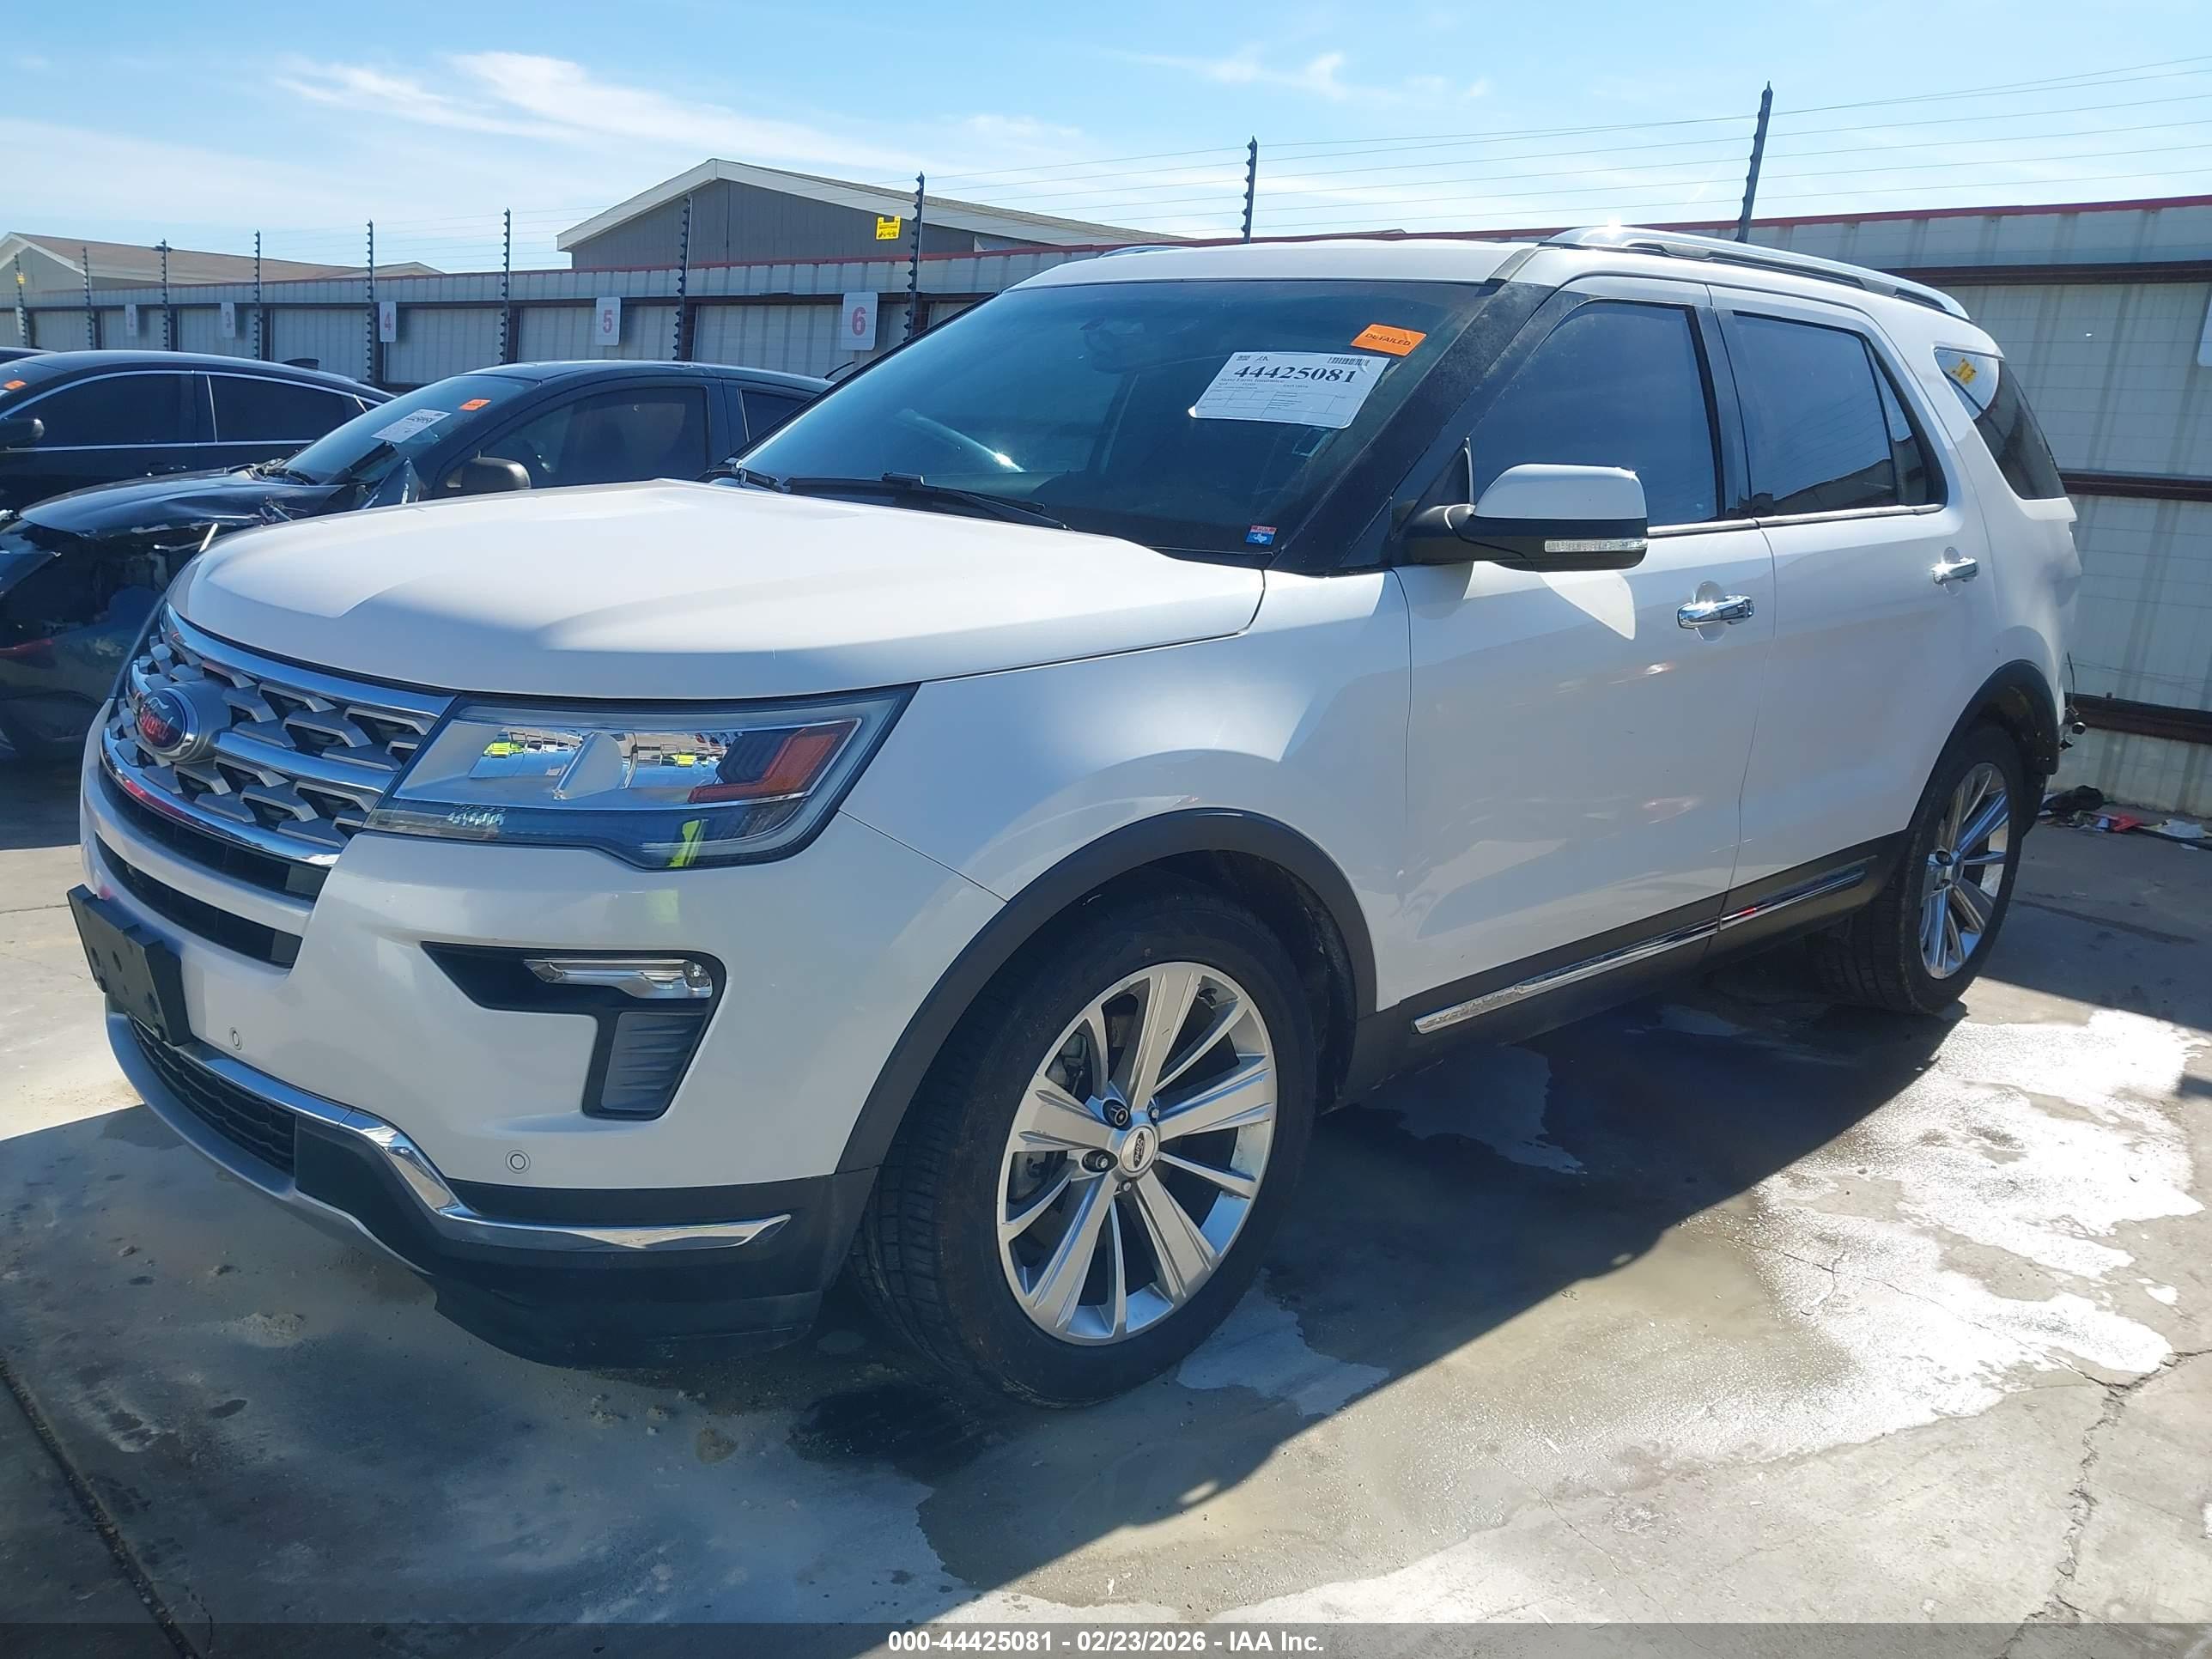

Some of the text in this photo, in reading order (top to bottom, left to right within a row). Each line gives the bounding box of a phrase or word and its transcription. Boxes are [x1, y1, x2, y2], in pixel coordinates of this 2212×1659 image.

[384, 312, 392, 331] 4
[603, 310, 612, 333] 5
[852, 307, 866, 336] 6
[1364, 332, 1412, 346] DETAILED
[1234, 365, 1357, 384] 44425081
[140, 696, 174, 740] Ford
[1134, 1137, 1145, 1162] Ford
